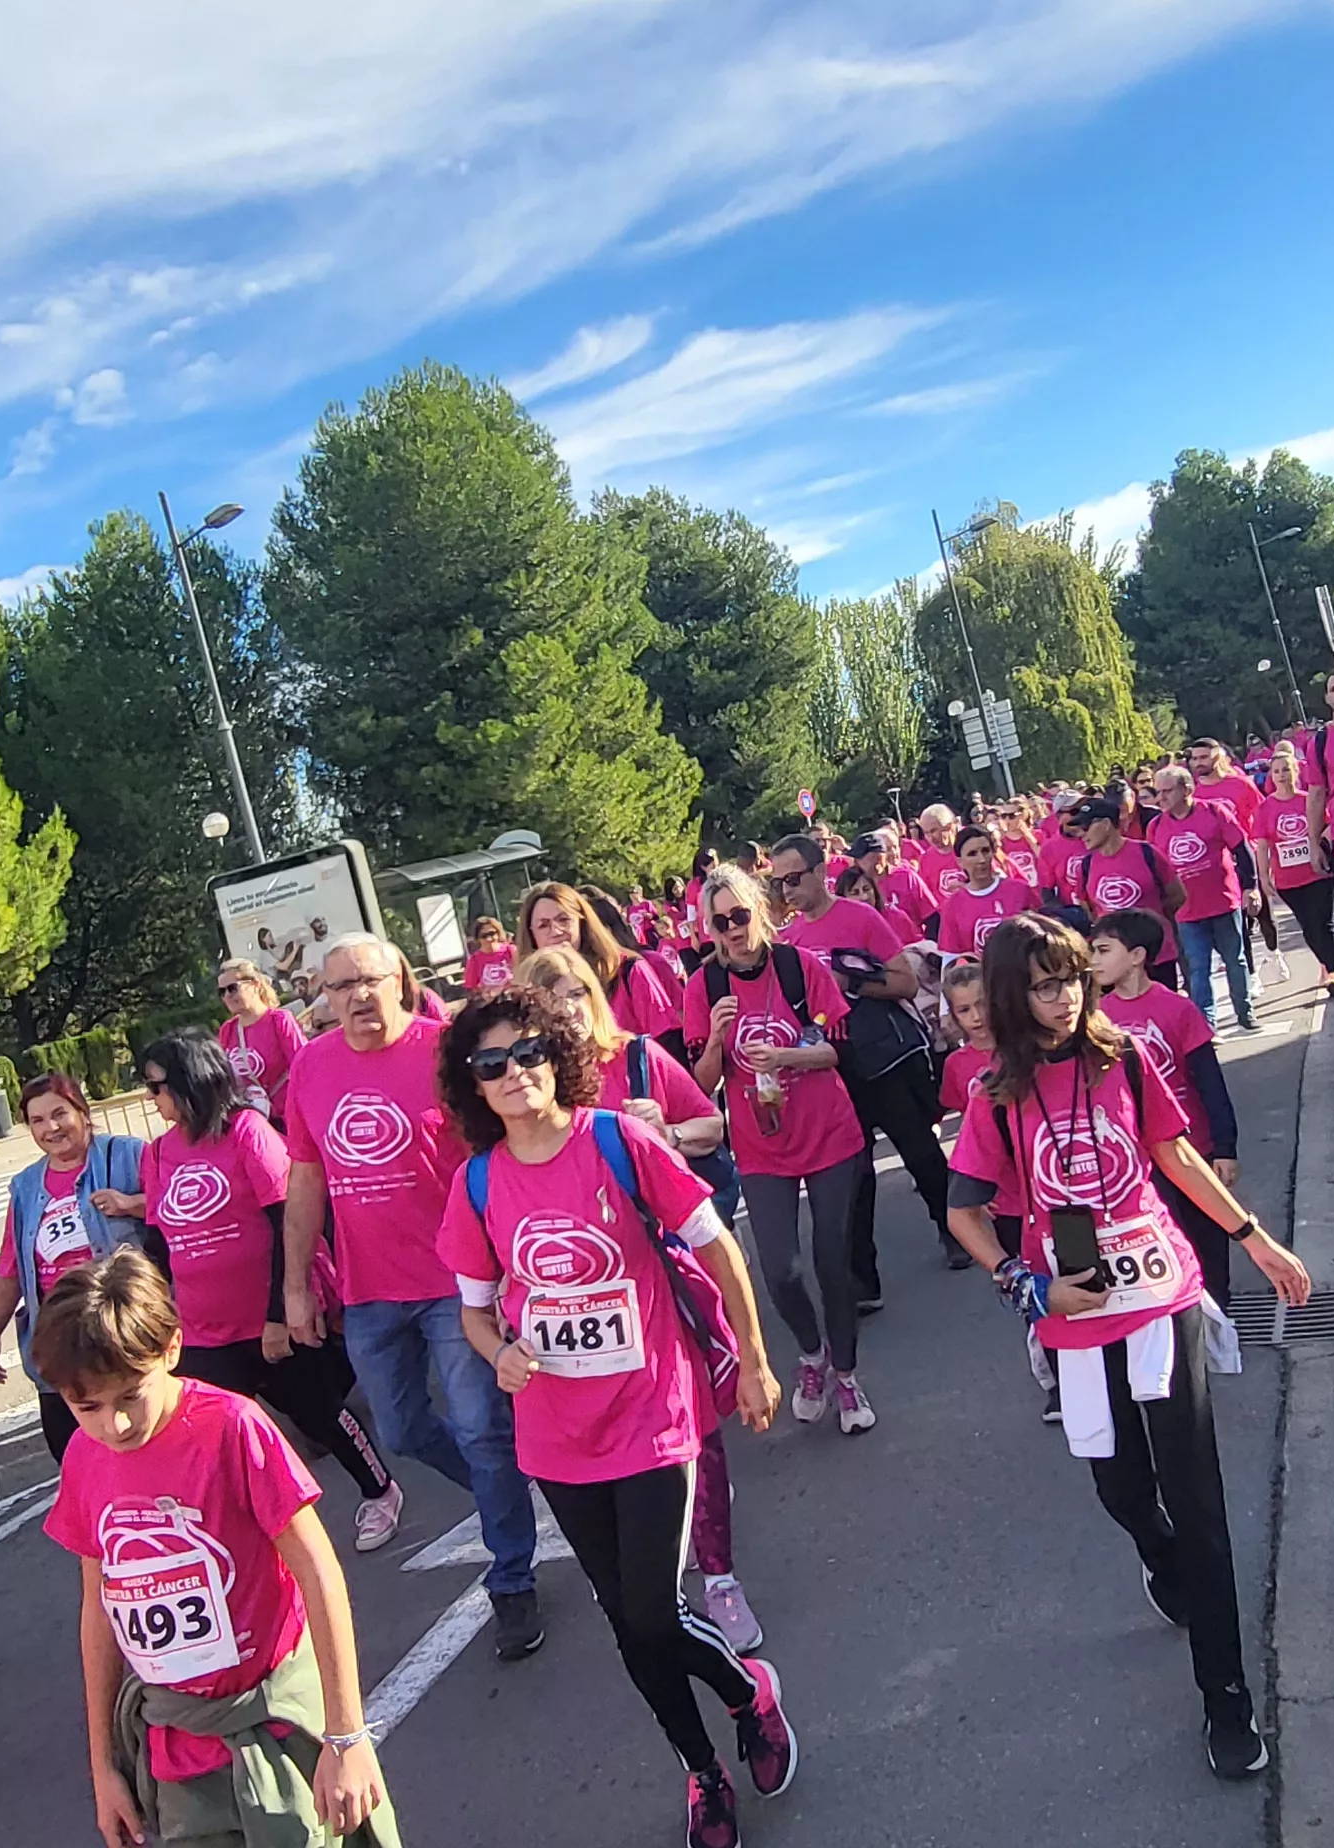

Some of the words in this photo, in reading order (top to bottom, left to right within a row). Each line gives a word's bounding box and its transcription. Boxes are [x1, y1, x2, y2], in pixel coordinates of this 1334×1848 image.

[1282, 846, 1309, 859] 2890
[1071, 1160, 1098, 1176] UNTOS
[46, 1215, 76, 1243] 35
[1101, 1246, 1168, 1289] 496
[570, 1303, 582, 1314] EL
[533, 1313, 626, 1352] 1481
[134, 1588, 147, 1600] EL
[148, 1576, 202, 1596] CÁNCER
